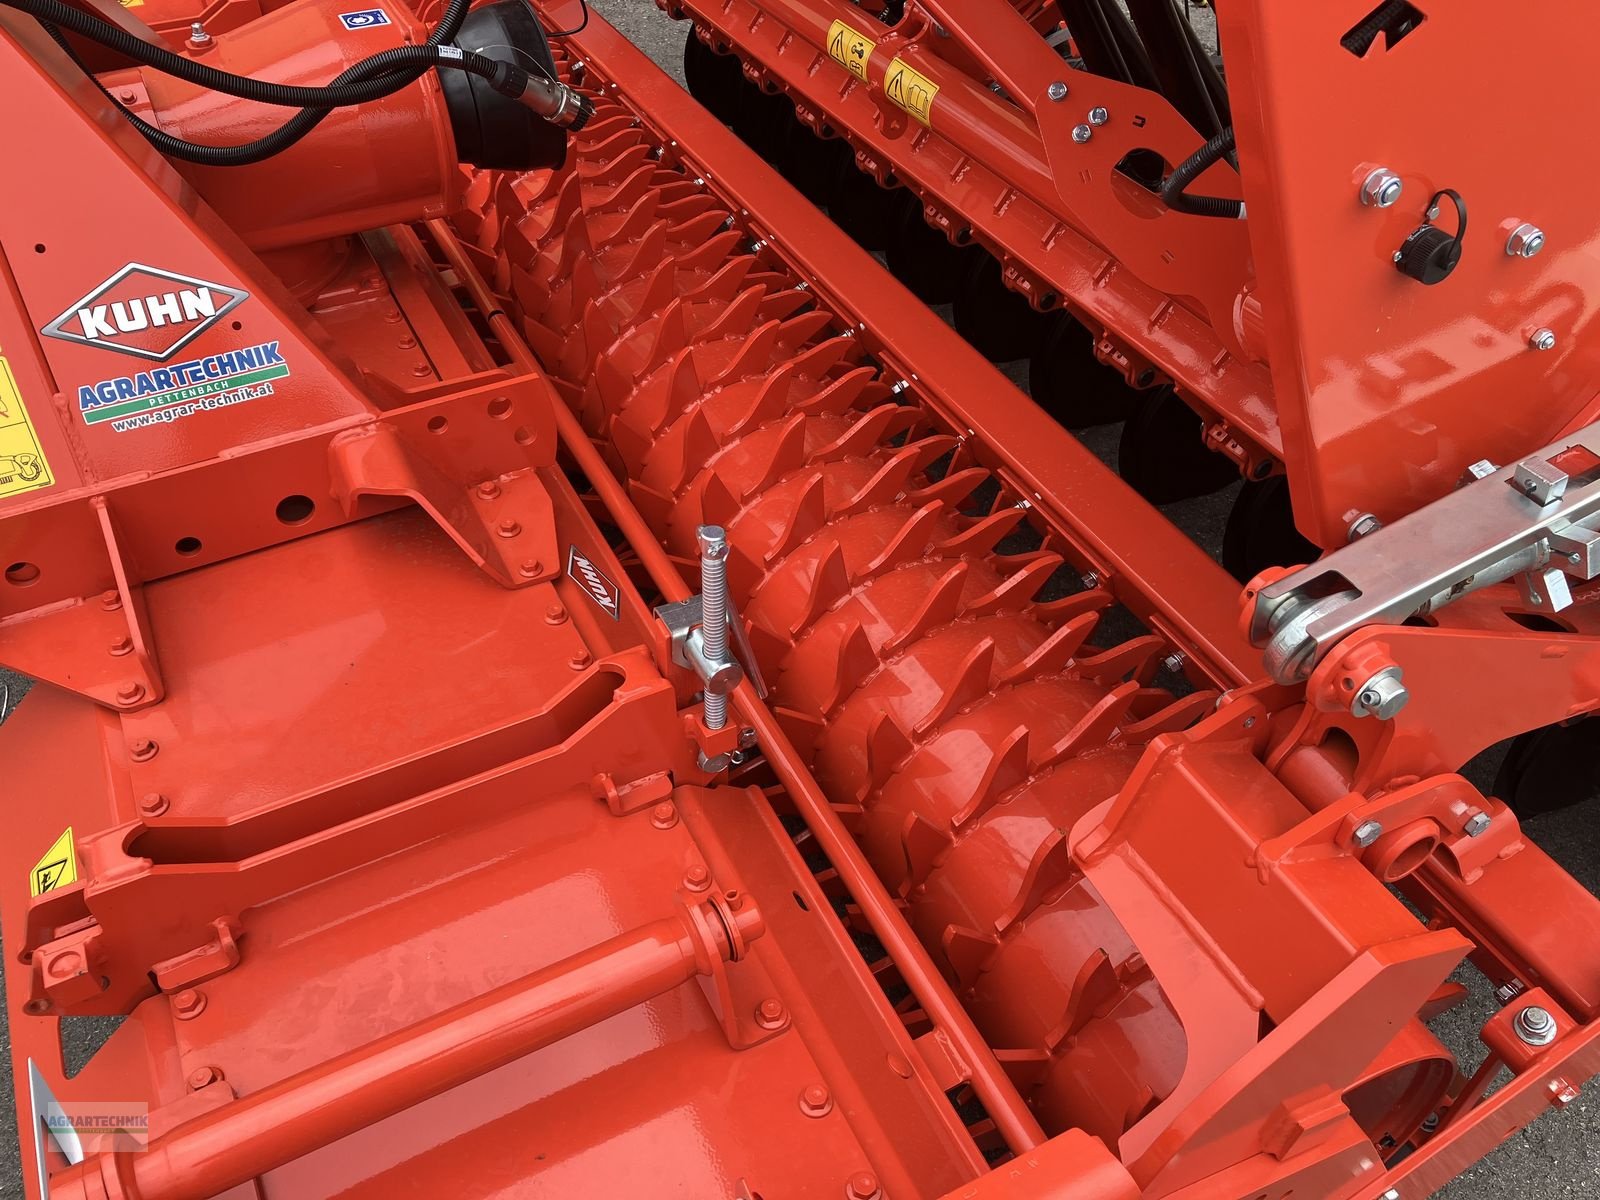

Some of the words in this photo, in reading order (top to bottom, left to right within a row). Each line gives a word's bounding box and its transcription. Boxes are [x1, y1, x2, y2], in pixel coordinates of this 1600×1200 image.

[78, 287, 216, 339] KUHN
[80, 342, 284, 409] AGRARTECHNIK
[149, 380, 229, 407] PETTENBACH
[113, 383, 273, 431] www.agrar-technik.at
[573, 555, 616, 608] KUHN
